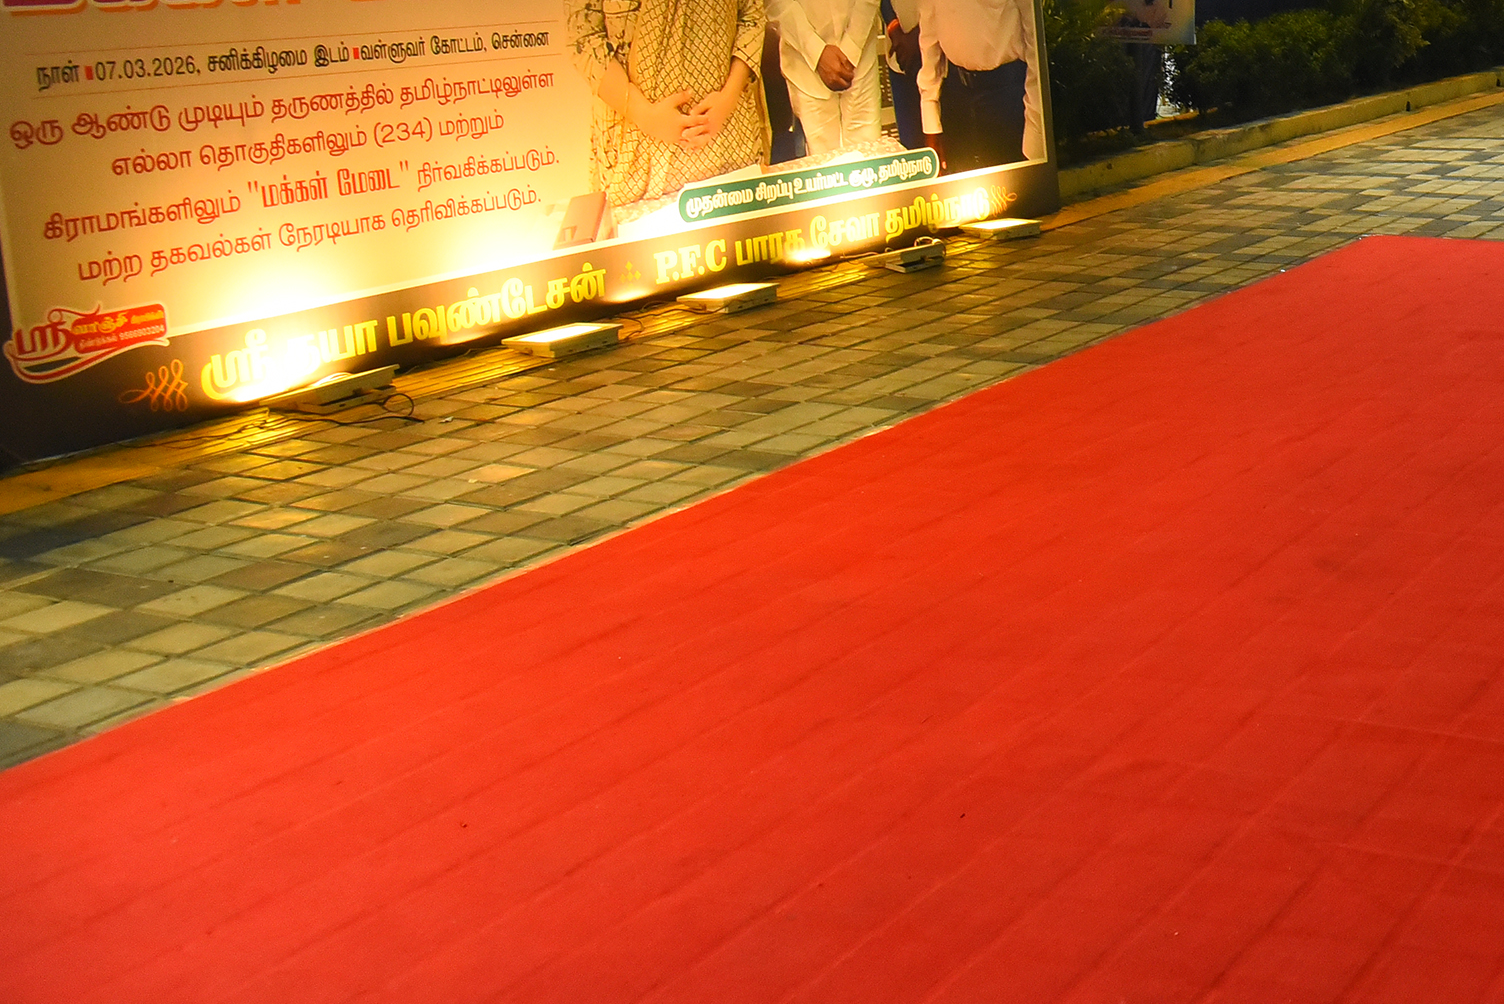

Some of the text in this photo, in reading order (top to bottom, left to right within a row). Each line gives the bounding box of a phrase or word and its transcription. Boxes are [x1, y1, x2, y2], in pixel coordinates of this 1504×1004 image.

[36, 60, 80, 91] நாள்
[207, 46, 307, 74] சனிக்கிழமை
[313, 41, 349, 67] இடம்
[360, 36, 425, 63] வள்ளுவர்
[430, 32, 487, 55] கோட்டம்,
[491, 29, 549, 49] சென்னை
[10, 69, 555, 149] ஒரு ஆண்டு முடியும் தருணத்தில் தமிழ்நாட்டிலுள்ள
[112, 108, 504, 176] எல்லா தொகுதிகளிலும் (234) மற்றும்
[44, 189, 241, 242] கிராமங்களிலும்
[417, 145, 560, 192] நிர்வகிக்கப்படும்.
[686, 188, 754, 219] முதன்மை
[755, 178, 793, 204] சிறப்பு
[794, 166, 848, 195] உயர்மட்ட
[878, 155, 933, 184] தமிழ்நாடு
[78, 183, 541, 286] மற்ற தகவல்கள் நேரடியாக தெரிவிக்கப்படும்.
[386, 262, 606, 347] பவுண்டேசன்
[654, 238, 727, 285] P.F.C
[809, 214, 880, 248] சேவா
[885, 186, 989, 242] தமிழ்நாடு
